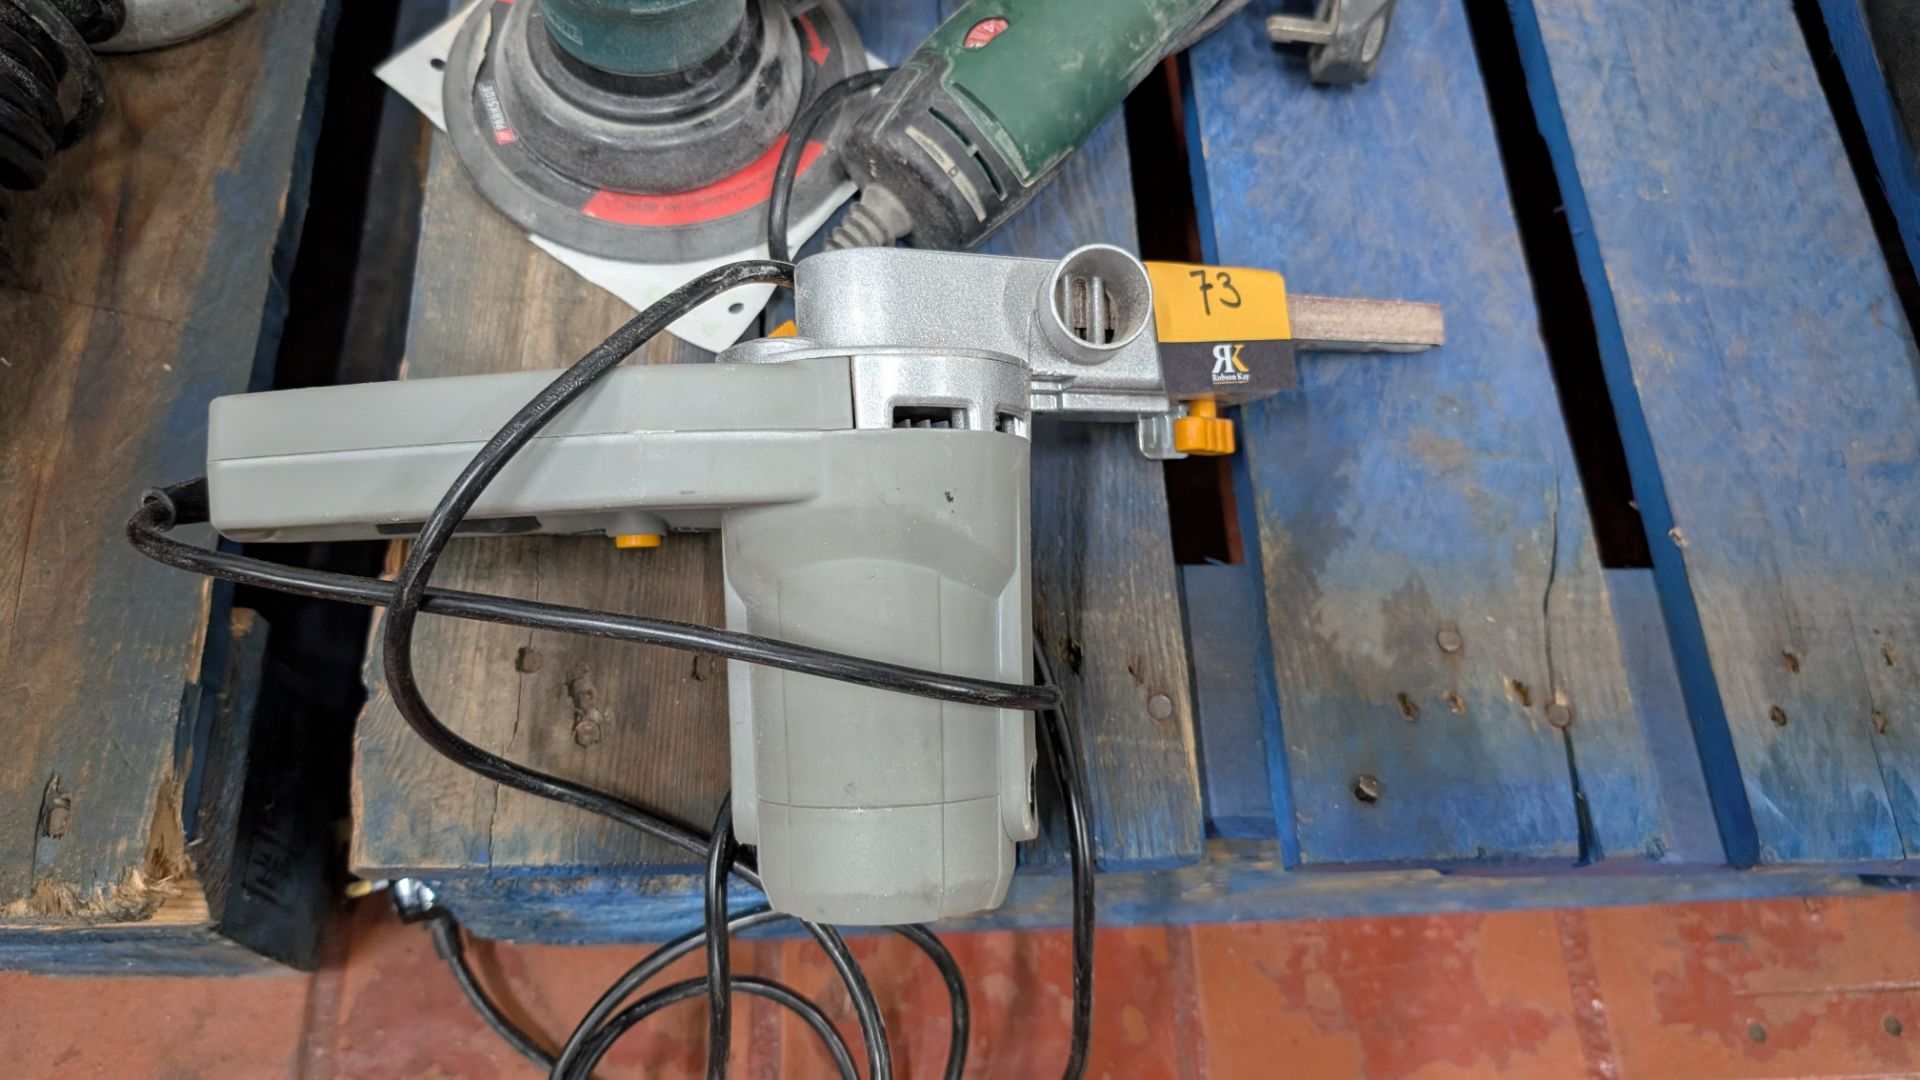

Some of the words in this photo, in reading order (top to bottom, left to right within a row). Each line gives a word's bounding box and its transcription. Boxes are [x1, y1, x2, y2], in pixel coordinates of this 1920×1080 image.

[1190, 270, 1241, 316] 73
[1212, 373, 1236, 382] Robson
[1237, 373, 1250, 382] Kay
